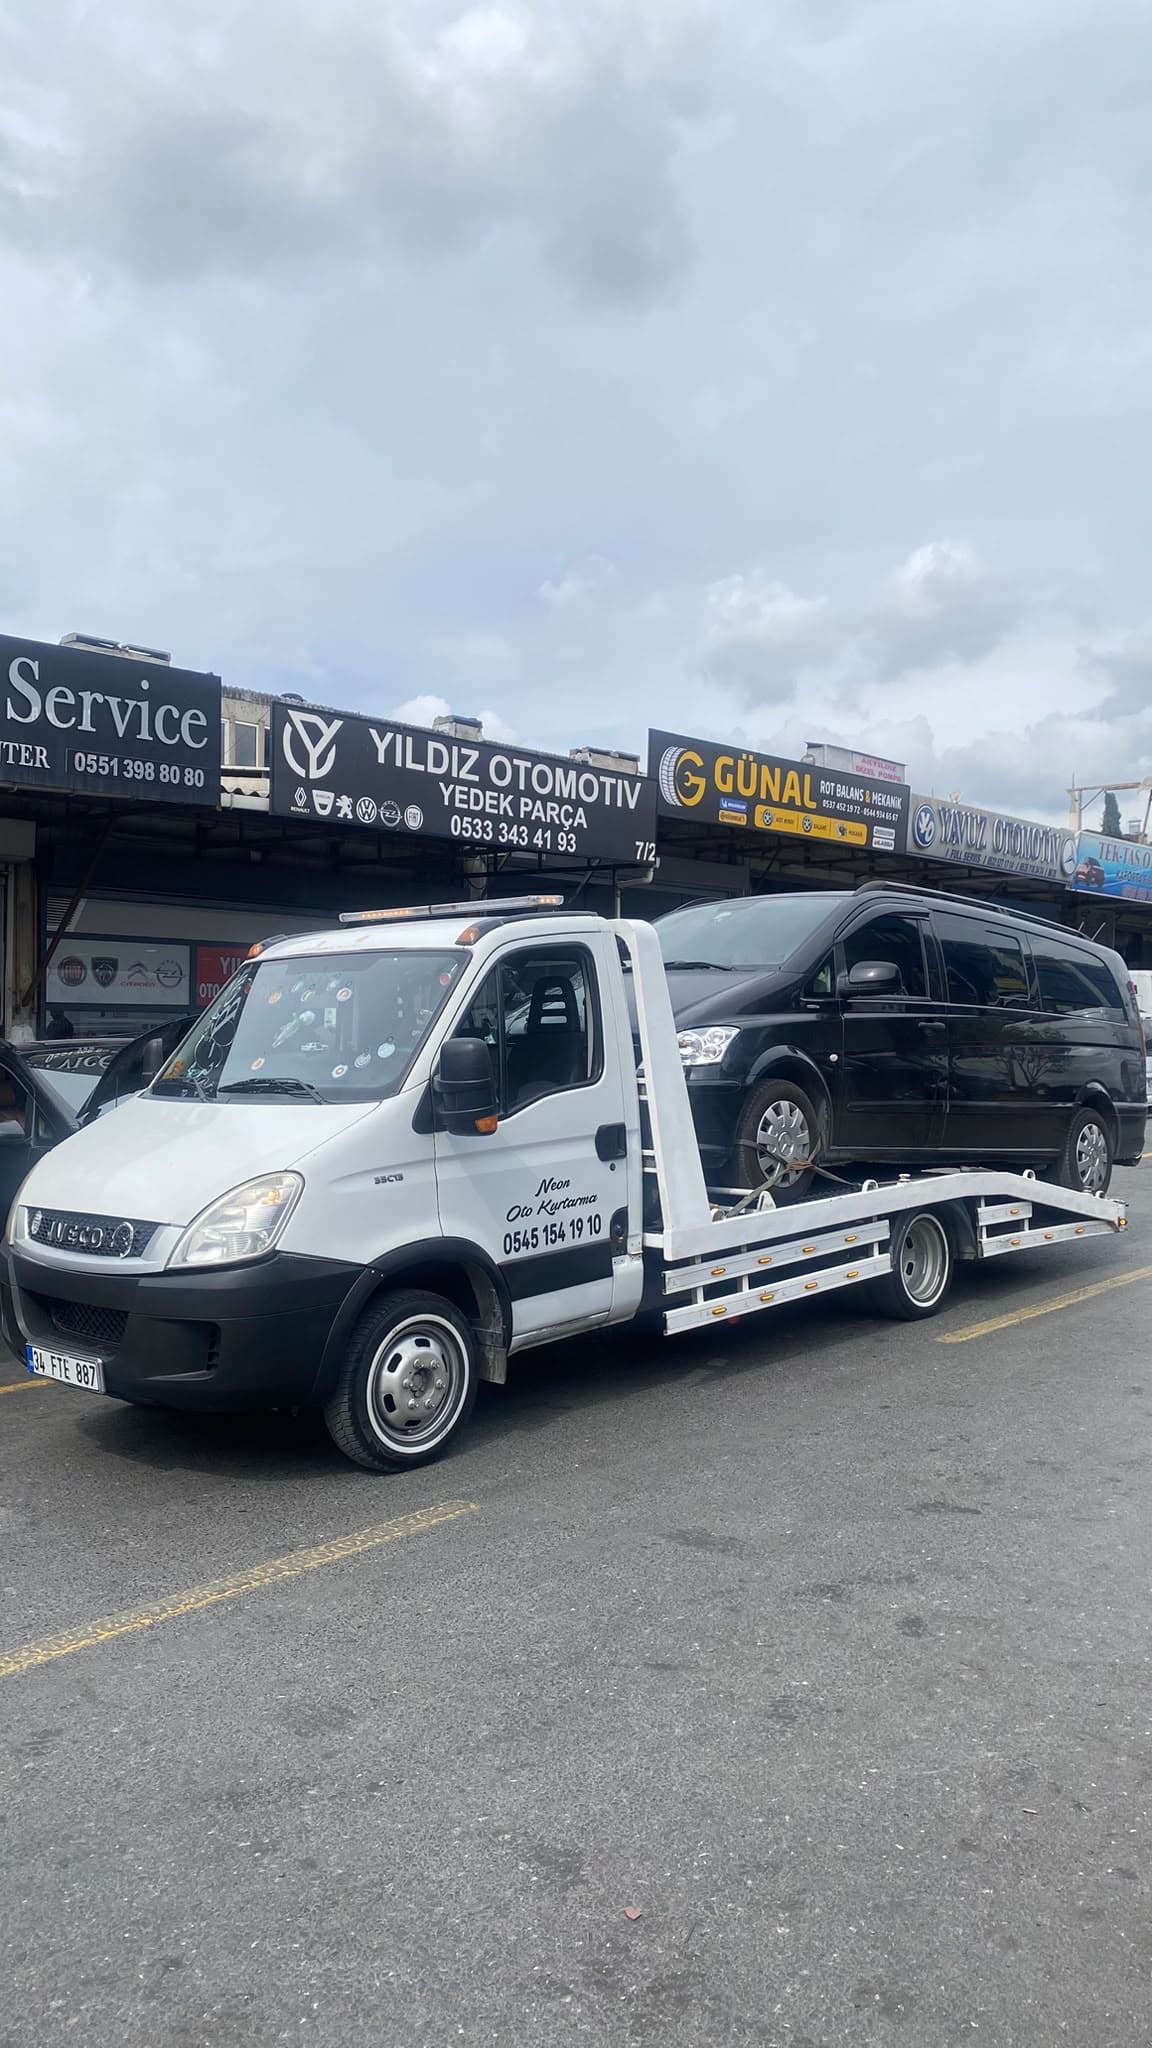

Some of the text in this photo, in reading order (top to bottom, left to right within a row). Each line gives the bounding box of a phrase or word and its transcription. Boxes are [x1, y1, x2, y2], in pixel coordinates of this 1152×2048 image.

[6, 656, 209, 749] Service
[74, 752, 205, 788] 0551 398 80 80
[368, 727, 642, 810] YILDIZ OTOMOTIV
[714, 754, 817, 809] GÜNAL
[439, 782, 588, 831] YEDEK PARÇA
[819, 780, 836, 796] ROT
[836, 784, 864, 802] BALANS
[865, 790, 871, 803] &
[823, 799, 836, 809] 0537
[836, 802, 846, 812] 452
[450, 814, 577, 853] 0533 343 41 93
[938, 806, 987, 849] YAVUZ
[635, 841, 657, 862] 7/2
[535, 1177, 570, 1197] Neon
[506, 1194, 598, 1223] Oto Kurtarma
[47, 1221, 104, 1249] IVECO
[503, 1213, 602, 1255] 0545 154 19 10
[34, 1350, 96, 1387] 34 FTE 887
